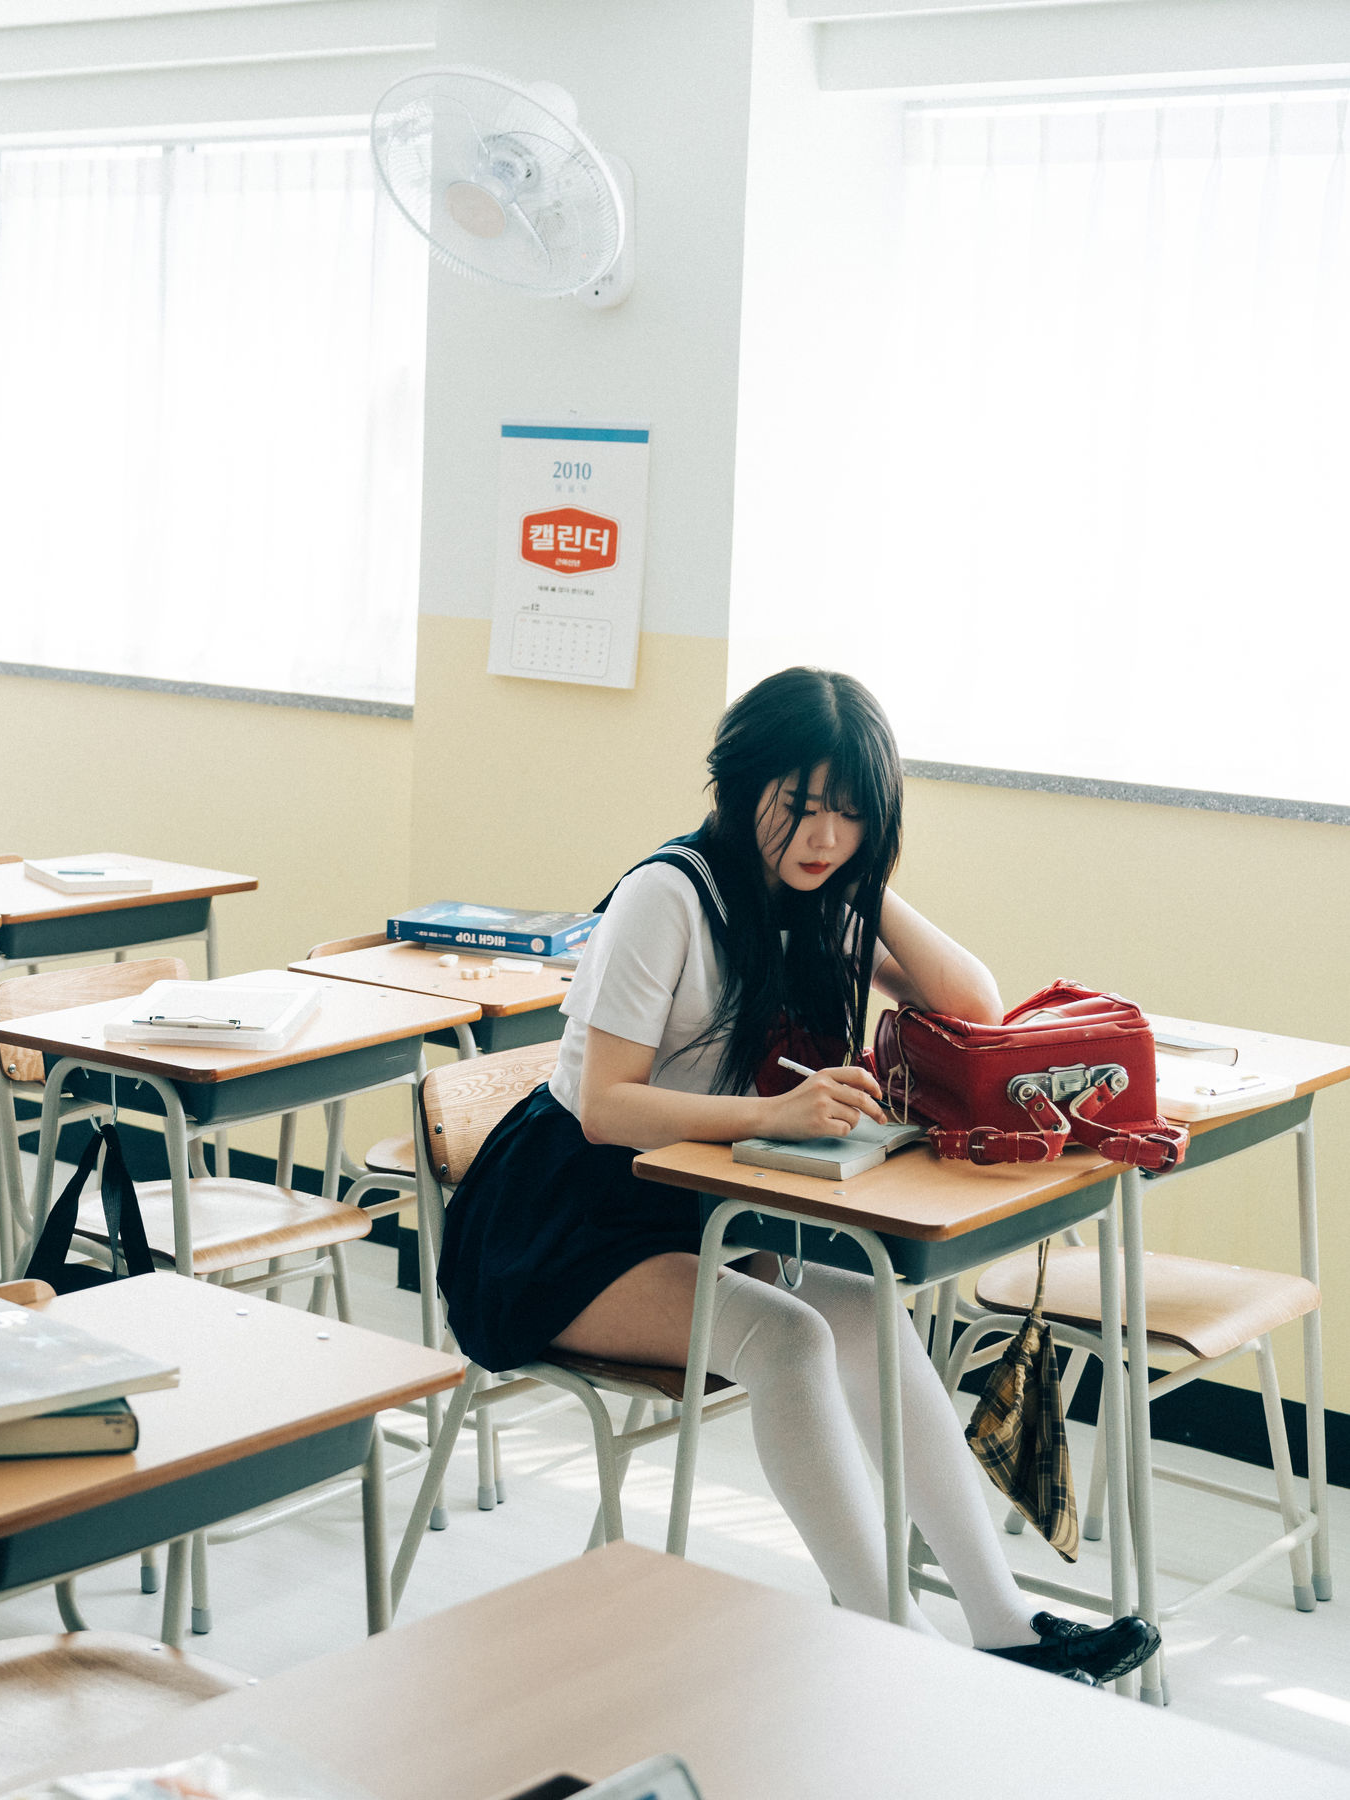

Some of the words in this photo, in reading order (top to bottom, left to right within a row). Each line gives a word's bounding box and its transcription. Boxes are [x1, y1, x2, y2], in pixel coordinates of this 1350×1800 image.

[552, 461, 592, 480] 2010
[528, 523, 610, 556] 캘린더
[455, 931, 477, 944] TOP
[478, 933, 506, 947] HIGH
